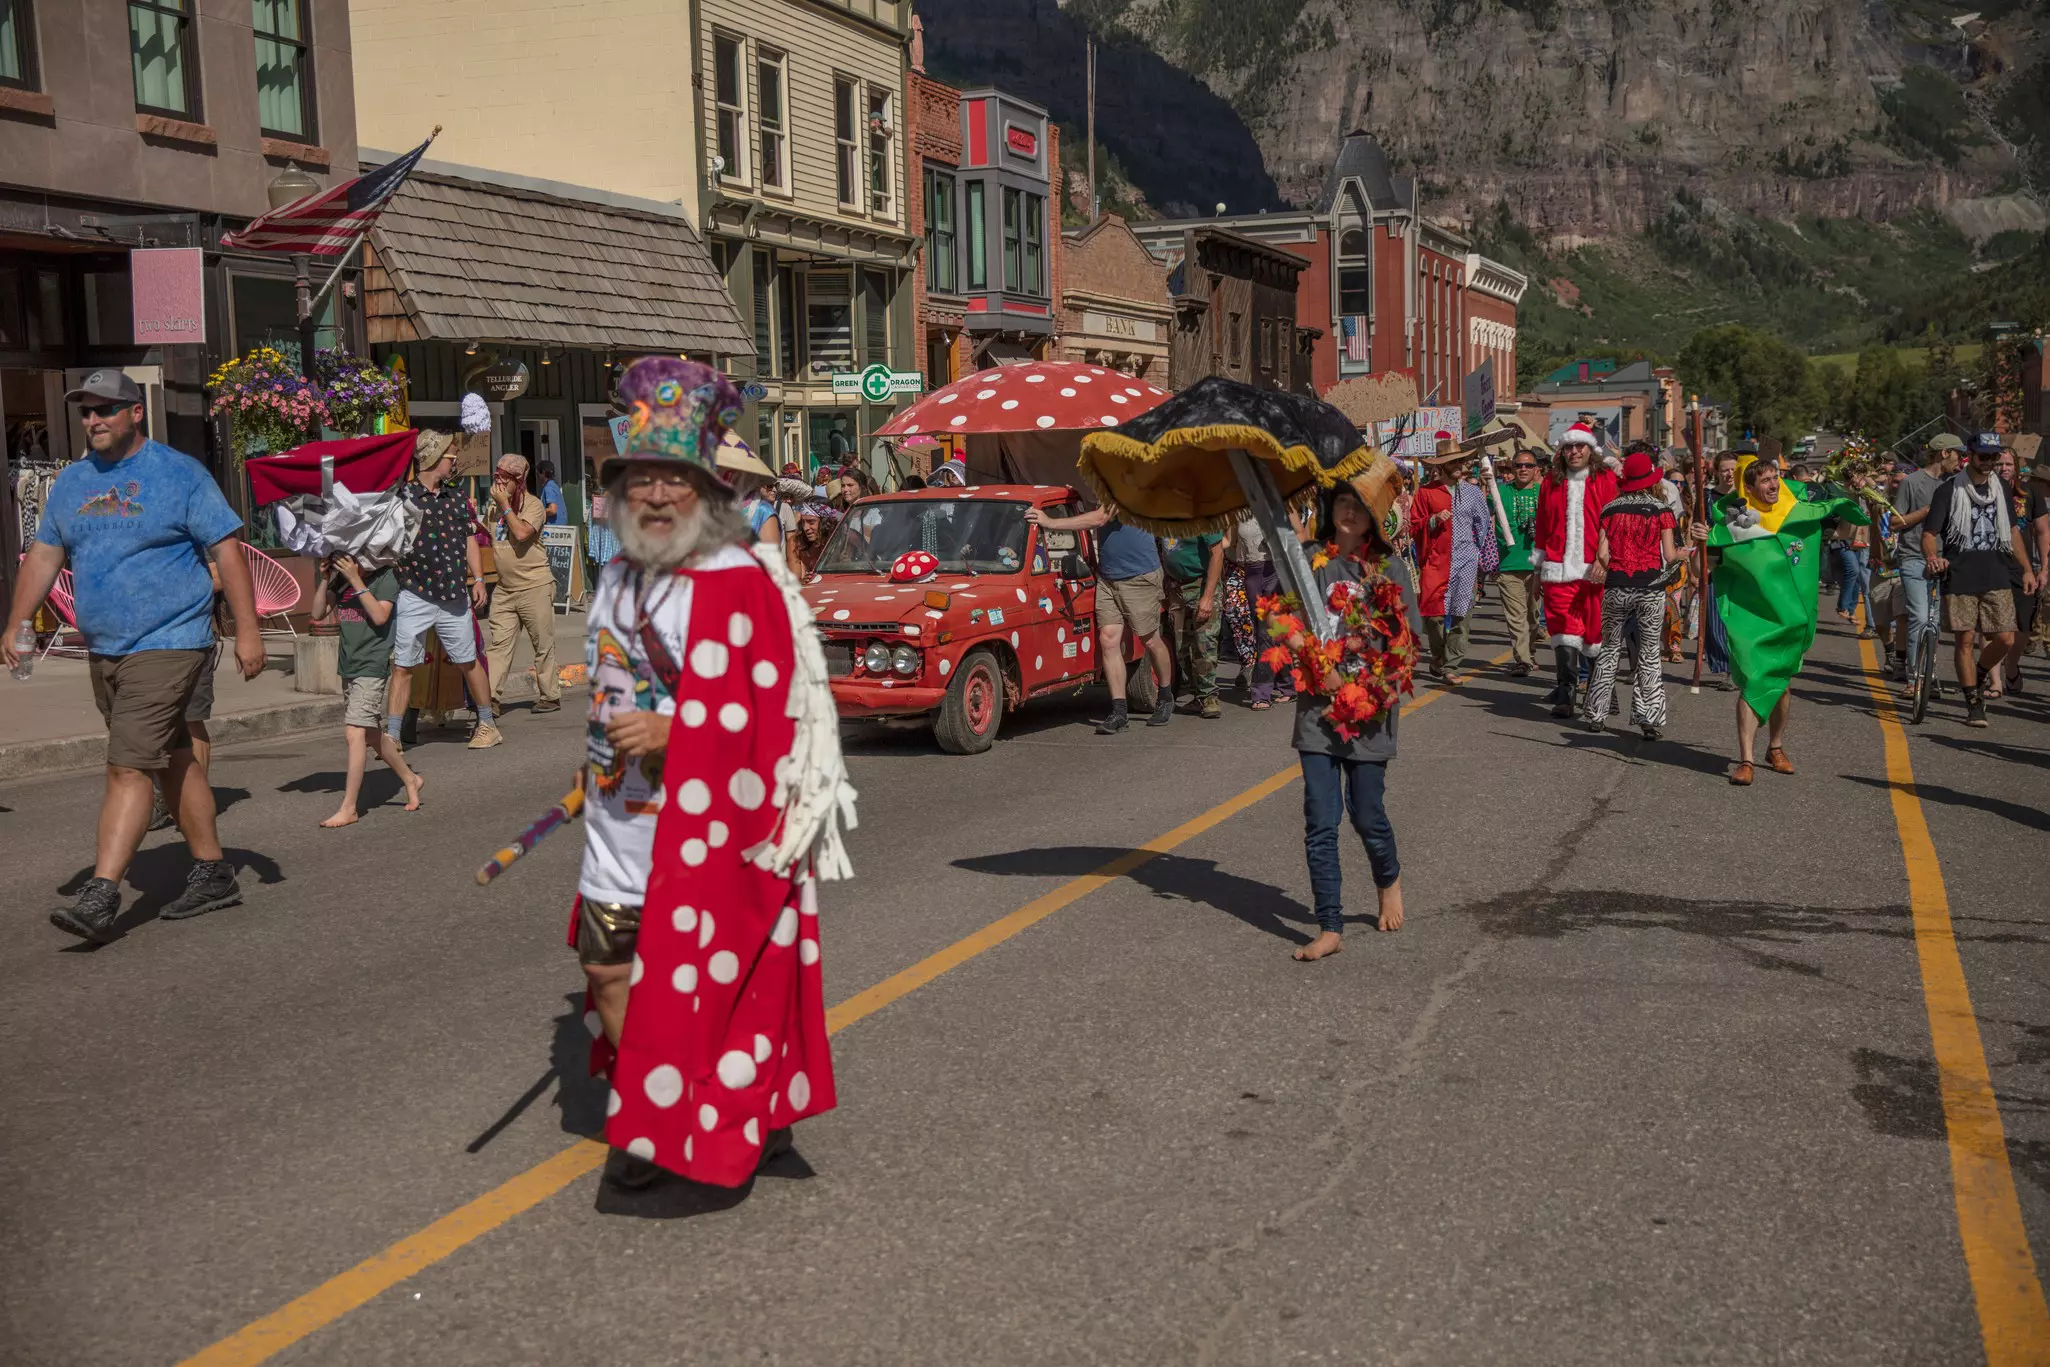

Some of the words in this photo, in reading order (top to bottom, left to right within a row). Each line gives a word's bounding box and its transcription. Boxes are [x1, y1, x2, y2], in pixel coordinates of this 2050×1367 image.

[138, 319, 161, 335] two
[164, 316, 198, 334] skirts
[1105, 316, 1136, 336] BANK
[486, 375, 523, 383] TELLURIDE
[490, 384, 520, 392] ANGLER
[71, 521, 144, 533] TELLURIDE
